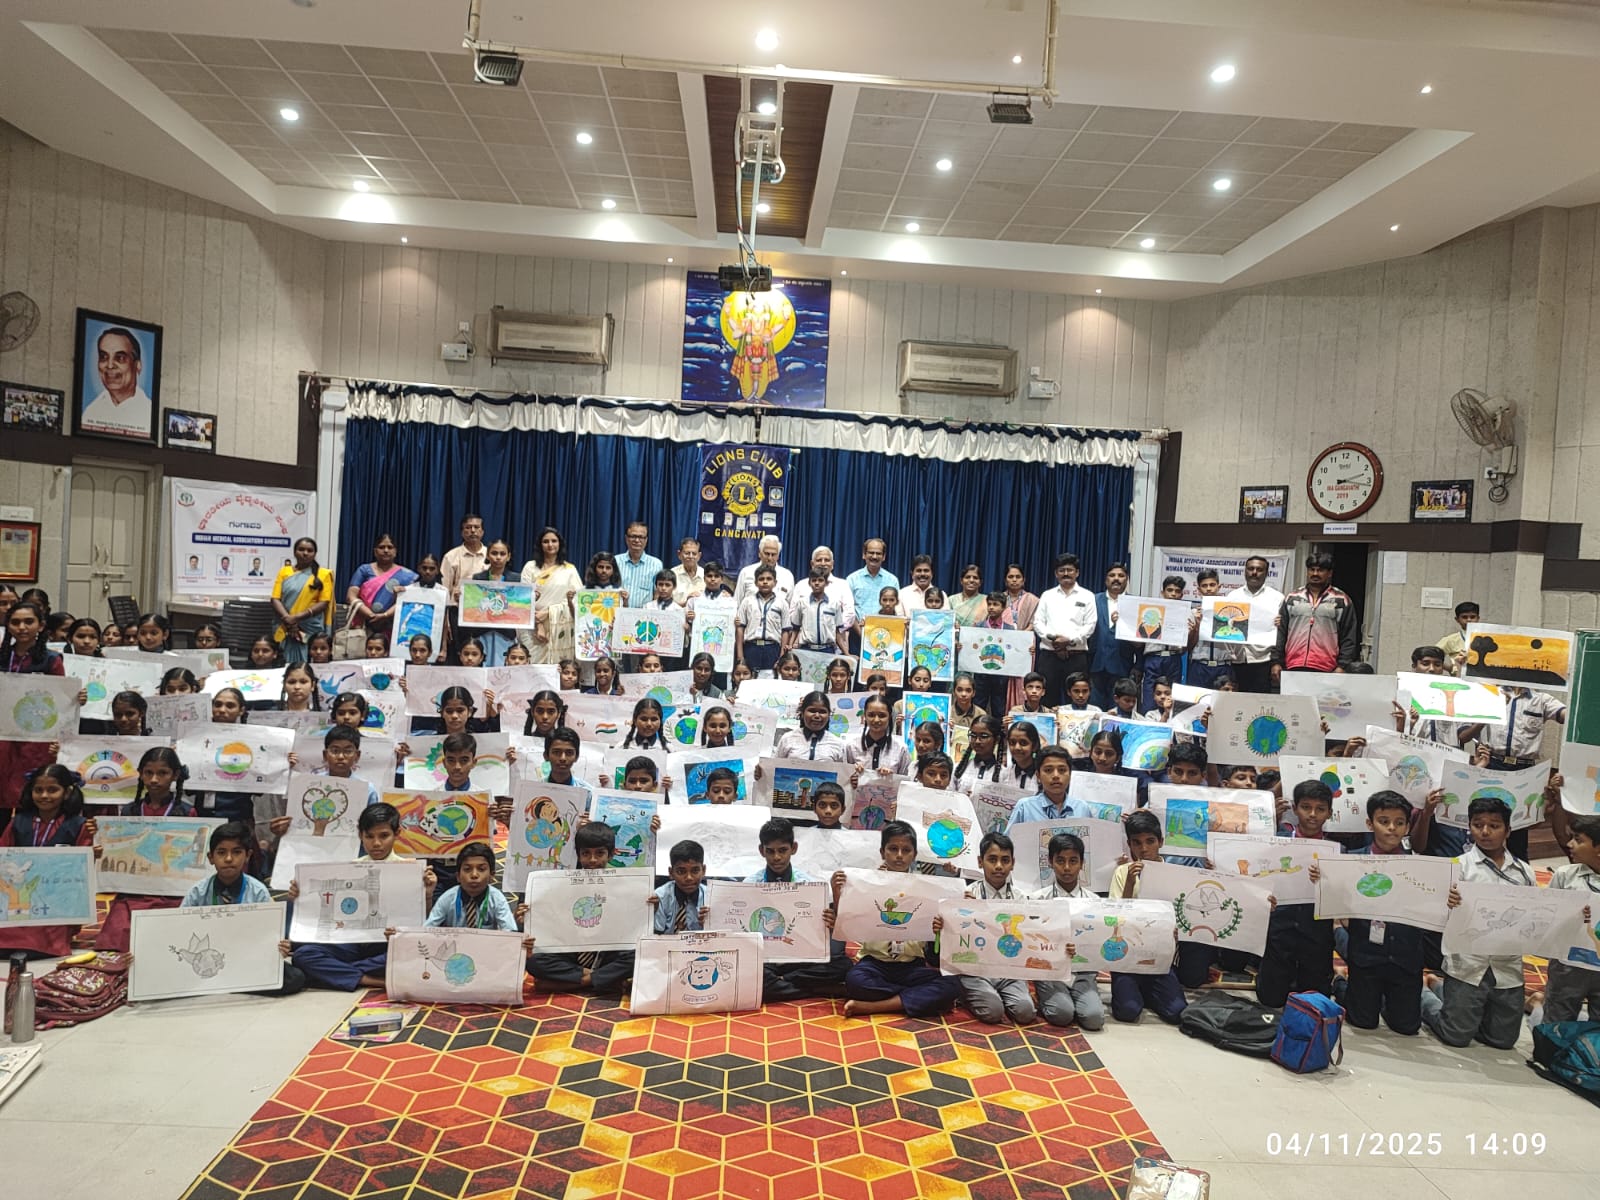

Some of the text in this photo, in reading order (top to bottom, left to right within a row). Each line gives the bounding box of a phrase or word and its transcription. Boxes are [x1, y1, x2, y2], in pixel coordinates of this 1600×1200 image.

[1342, 452, 1350, 460] 12
[705, 448, 783, 479] LIONS CLUB
[731, 474, 759, 485] LIONS
[739, 486, 750, 502] L
